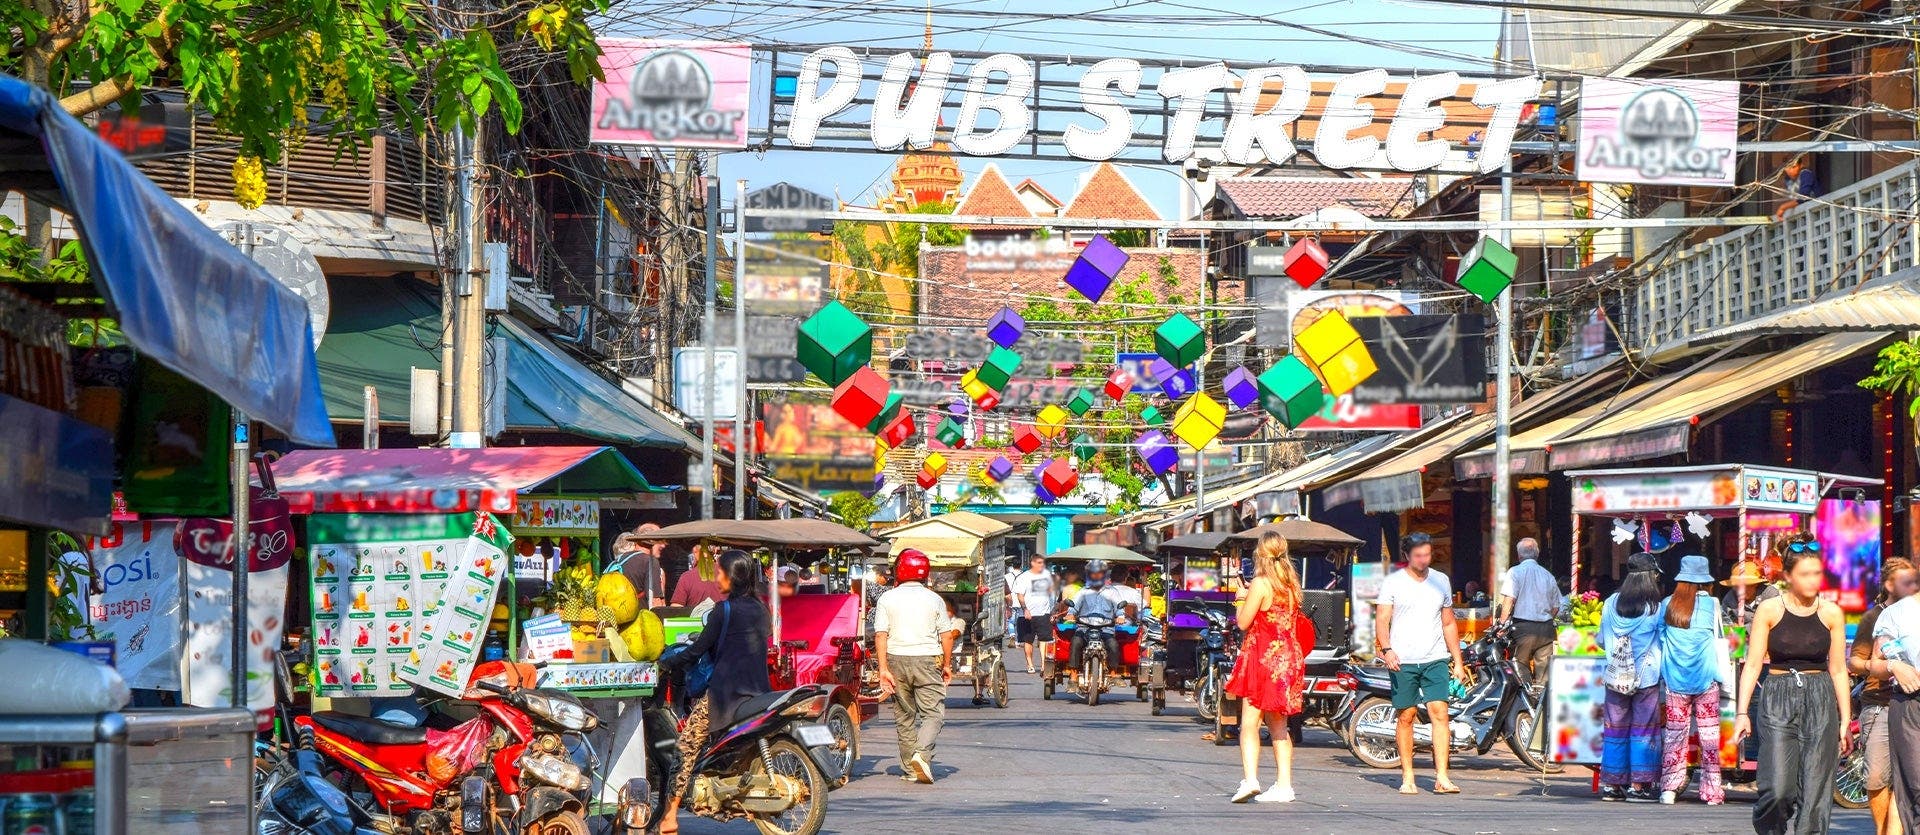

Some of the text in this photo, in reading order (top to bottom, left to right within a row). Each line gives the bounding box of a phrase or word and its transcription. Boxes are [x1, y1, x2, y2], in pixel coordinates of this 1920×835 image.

[598, 97, 744, 140] Angkor
[787, 46, 1543, 175] PUB STREET
[1586, 134, 1731, 179] Angkor
[93, 550, 152, 593] psi
